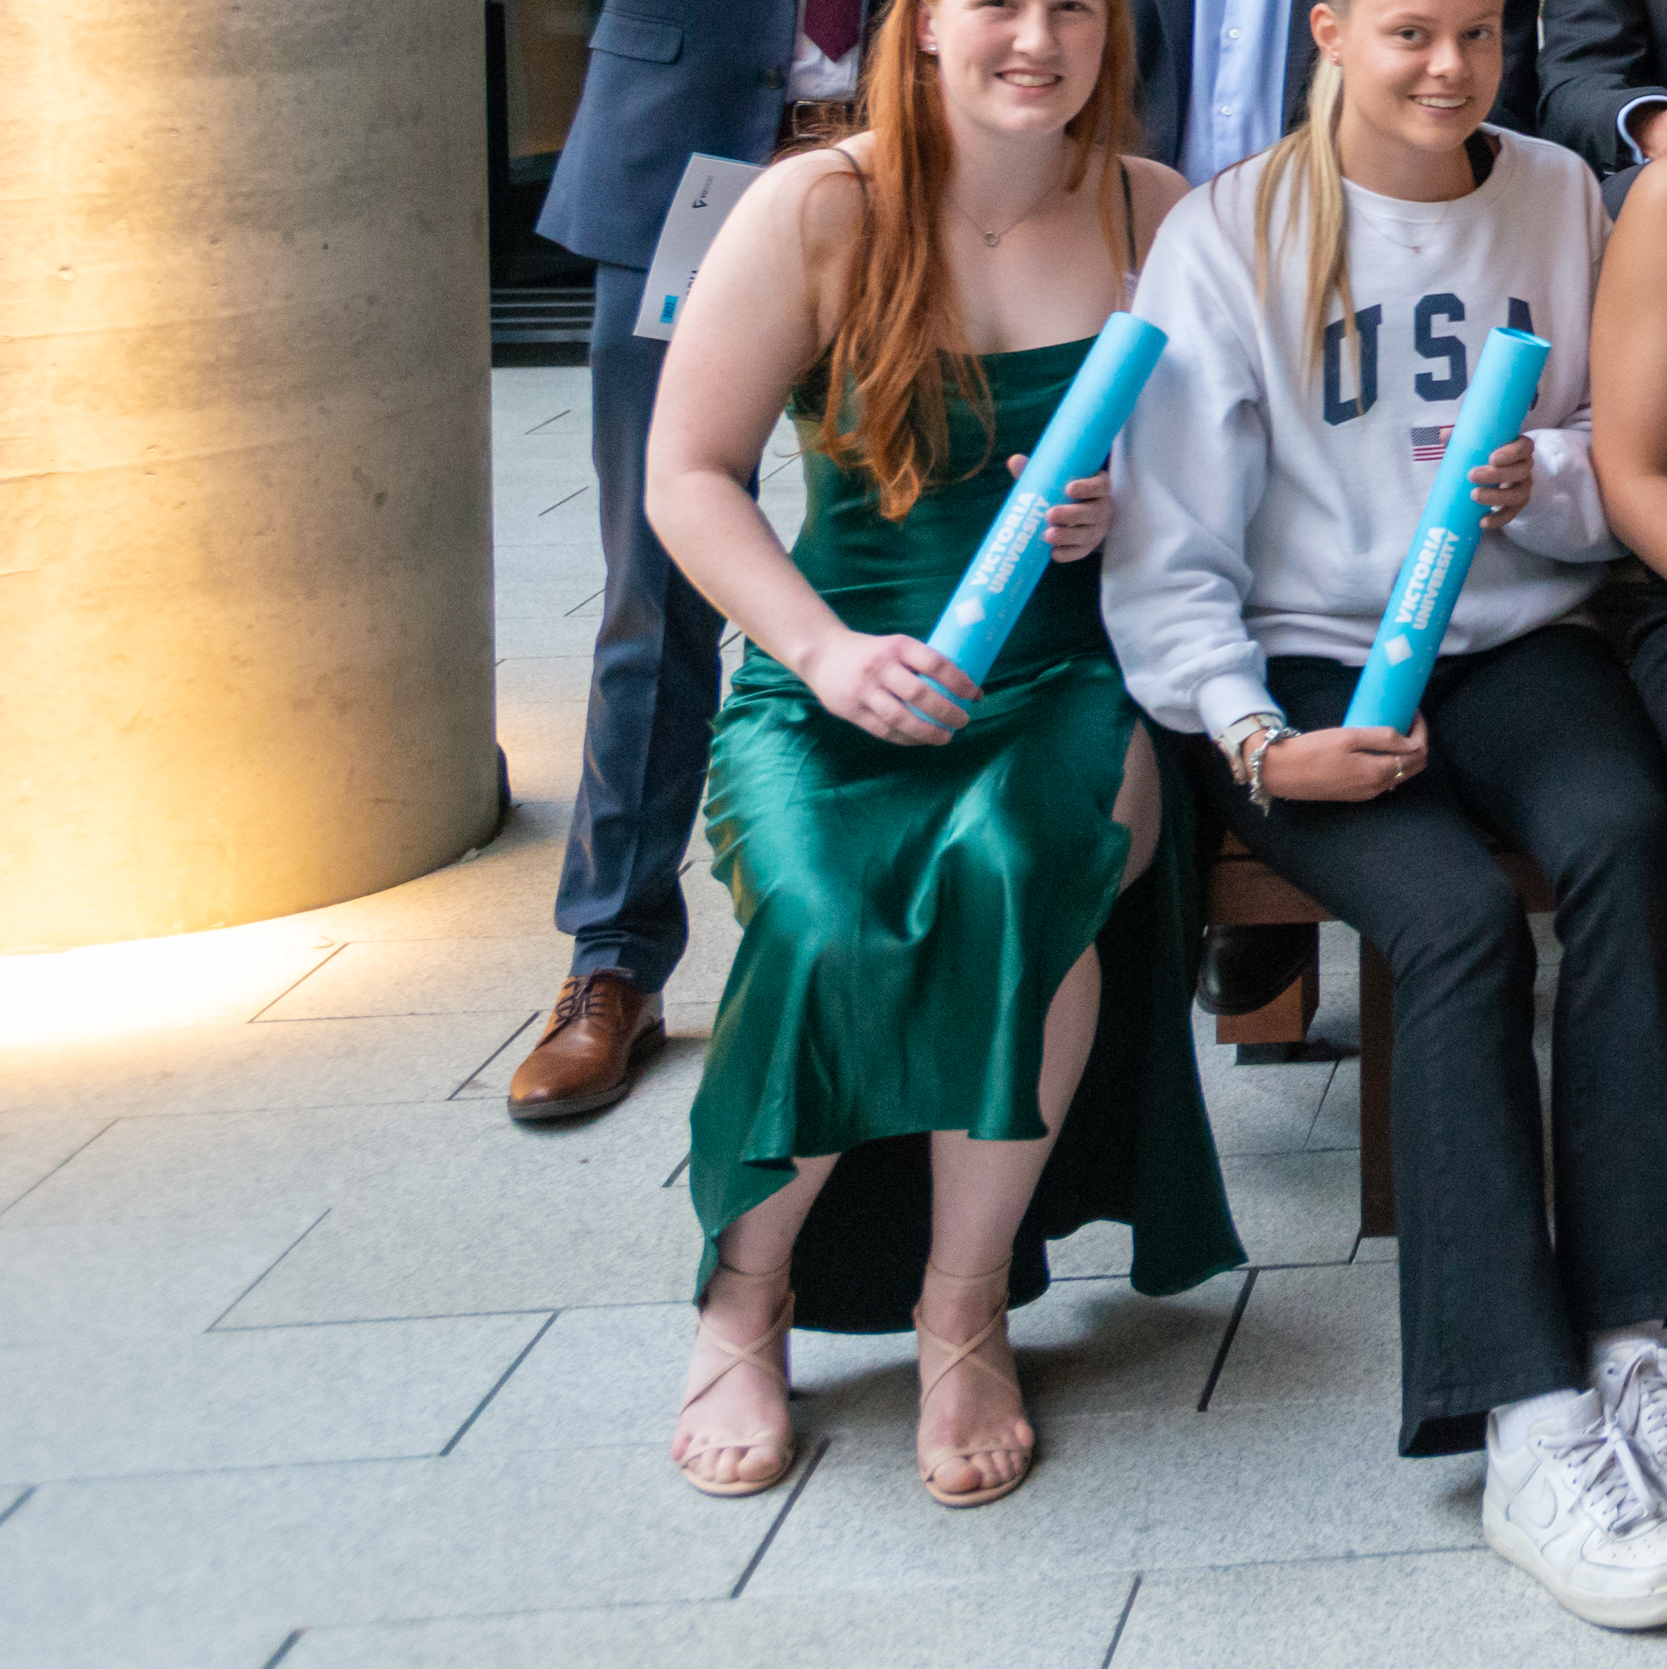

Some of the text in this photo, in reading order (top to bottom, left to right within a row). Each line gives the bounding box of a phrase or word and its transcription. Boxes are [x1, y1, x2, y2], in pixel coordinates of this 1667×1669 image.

[970, 493, 1036, 585] VICTORIA
[988, 495, 1049, 594] UNIVERSITY
[1395, 527, 1446, 623] VICTORIA
[1412, 531, 1460, 630] UNIVERSITY
